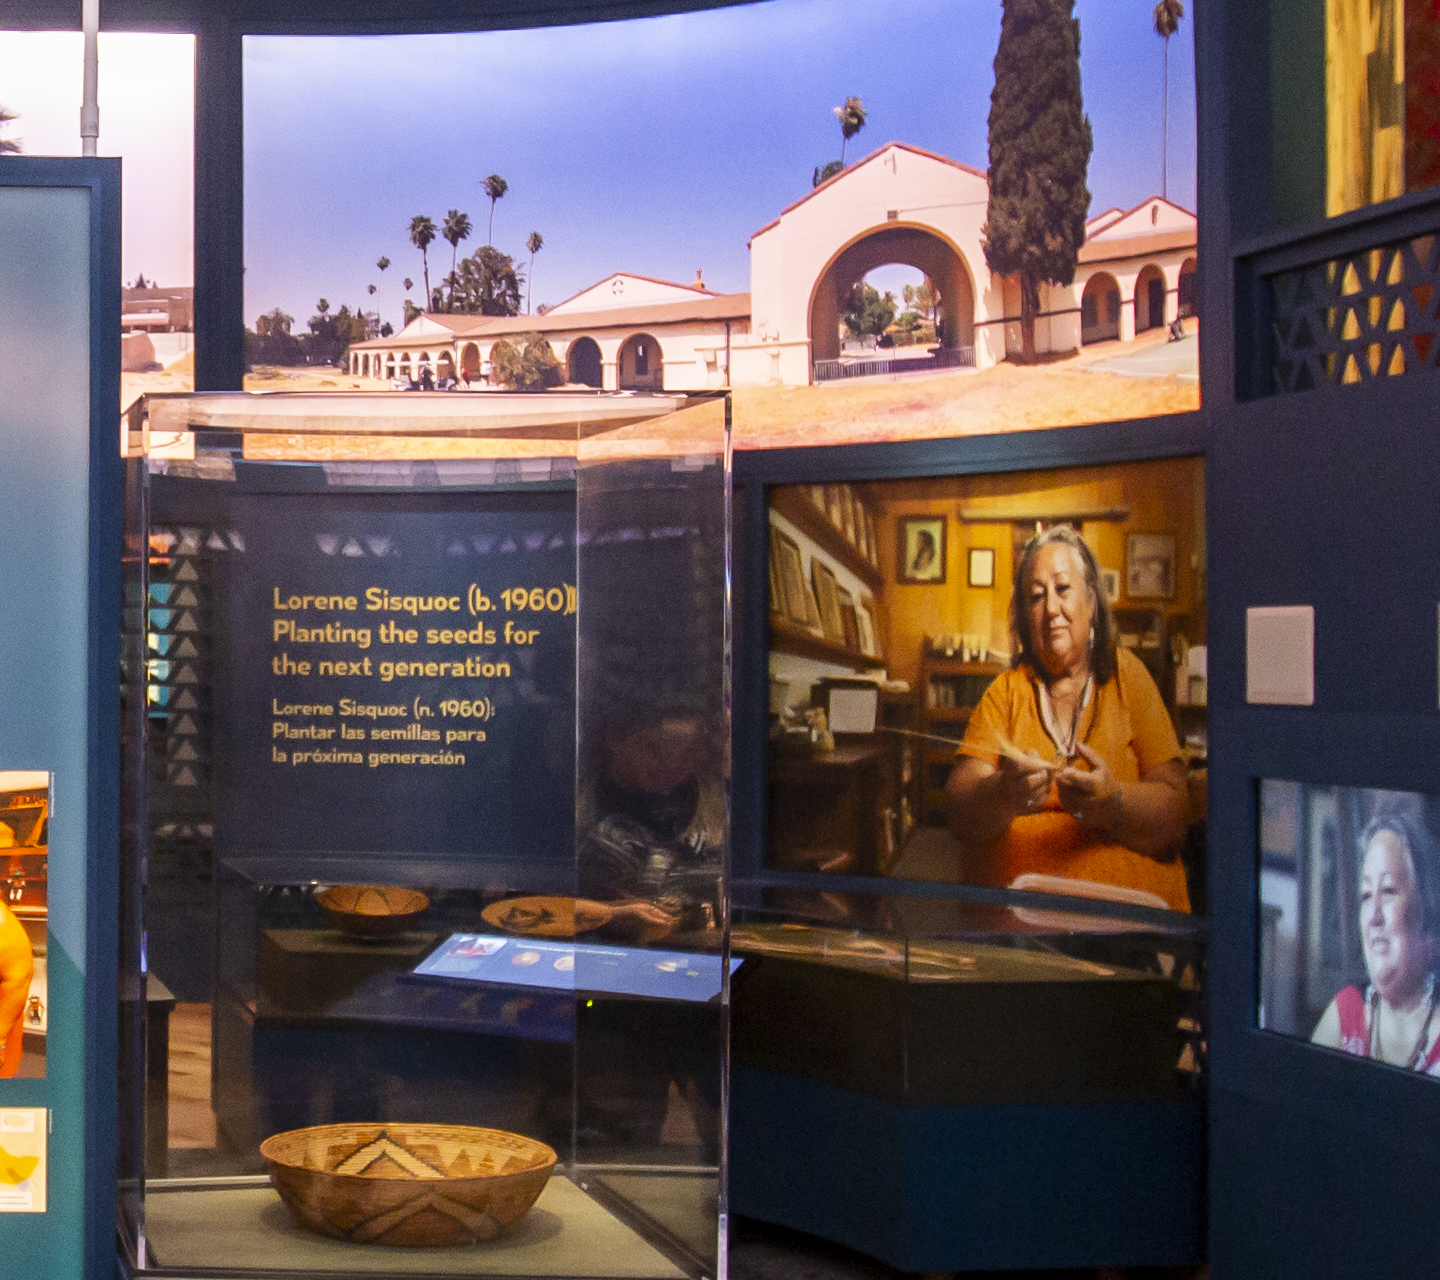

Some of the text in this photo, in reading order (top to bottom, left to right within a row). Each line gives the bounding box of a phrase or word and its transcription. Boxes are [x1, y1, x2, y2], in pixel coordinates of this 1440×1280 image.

[273, 587, 358, 610] Lorene
[365, 586, 460, 616] Sisquoc
[467, 583, 496, 615] (b.
[273, 618, 539, 648] Planting the seeds for
[271, 653, 511, 682] the next generation
[272, 698, 334, 716] Lorene
[338, 697, 407, 719] Sisquoc
[271, 721, 485, 744] Plantar las semillas para
[271, 745, 465, 768] la próxima generación
